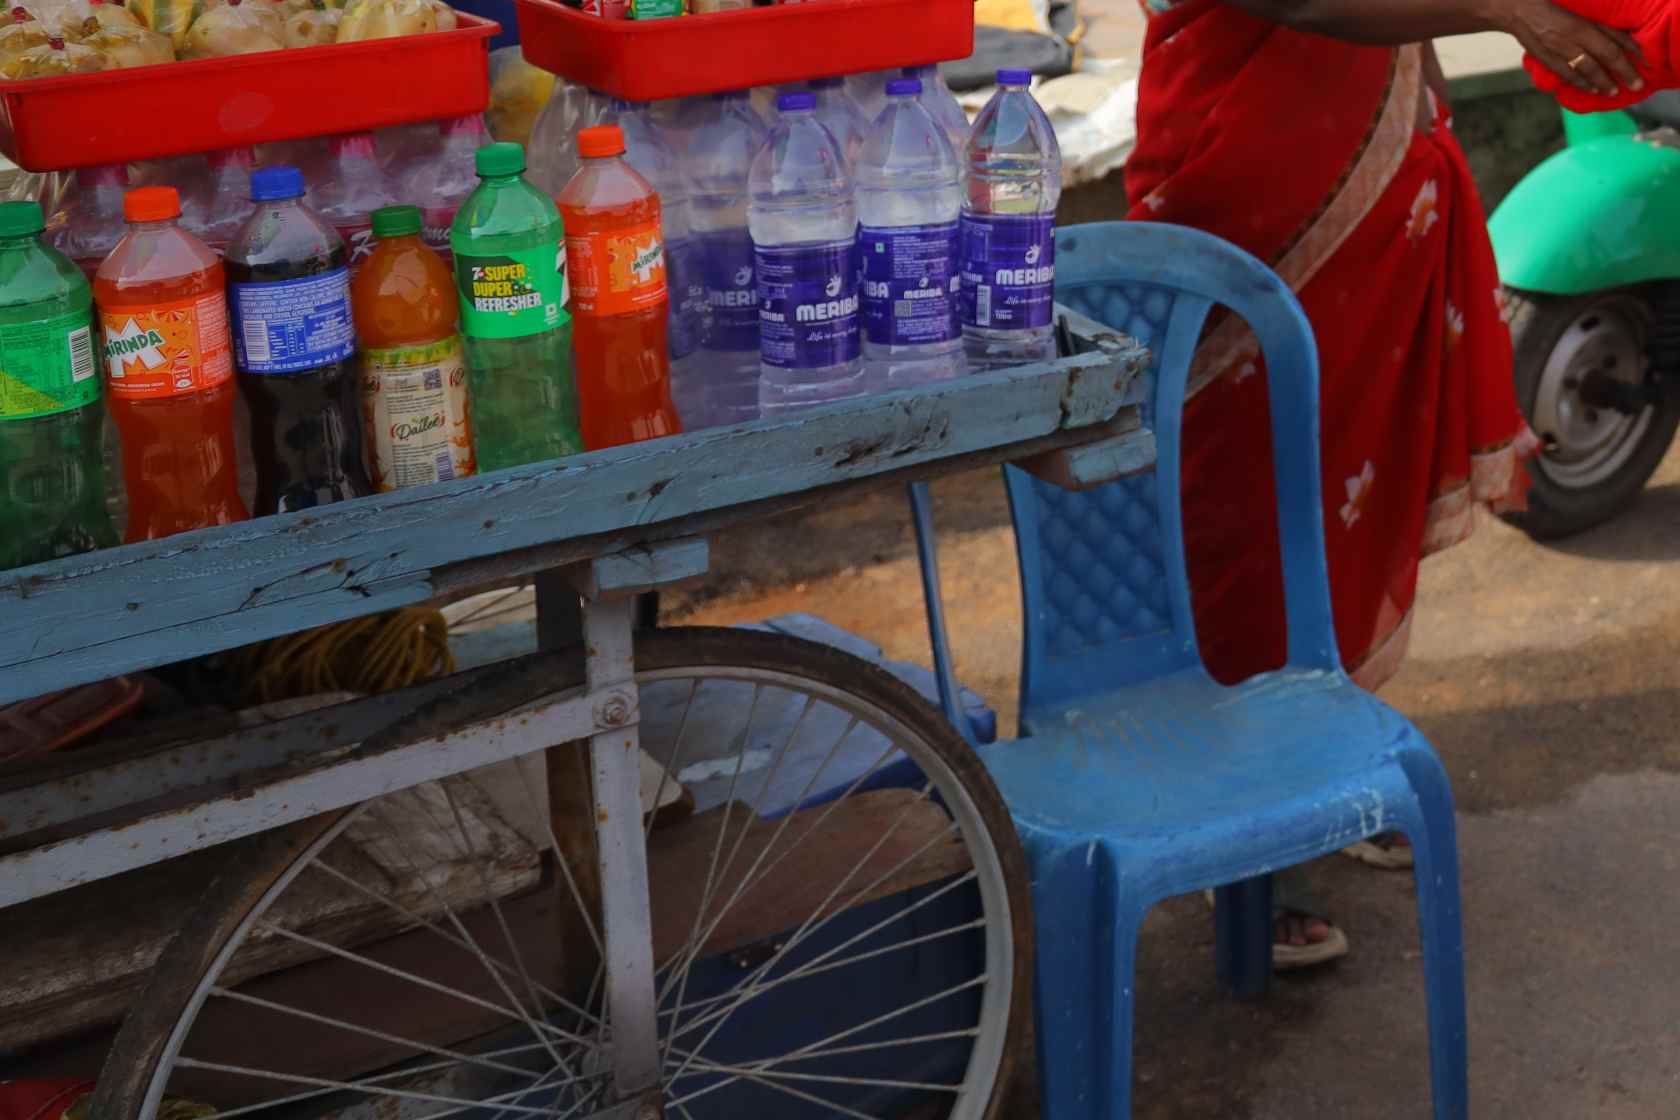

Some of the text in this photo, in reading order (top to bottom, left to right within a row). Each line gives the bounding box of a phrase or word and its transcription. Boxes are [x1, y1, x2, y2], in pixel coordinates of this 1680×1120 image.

[485, 264, 526, 281] SUPER
[473, 281, 513, 297] DUPER
[475, 292, 542, 312] REFRESHER
